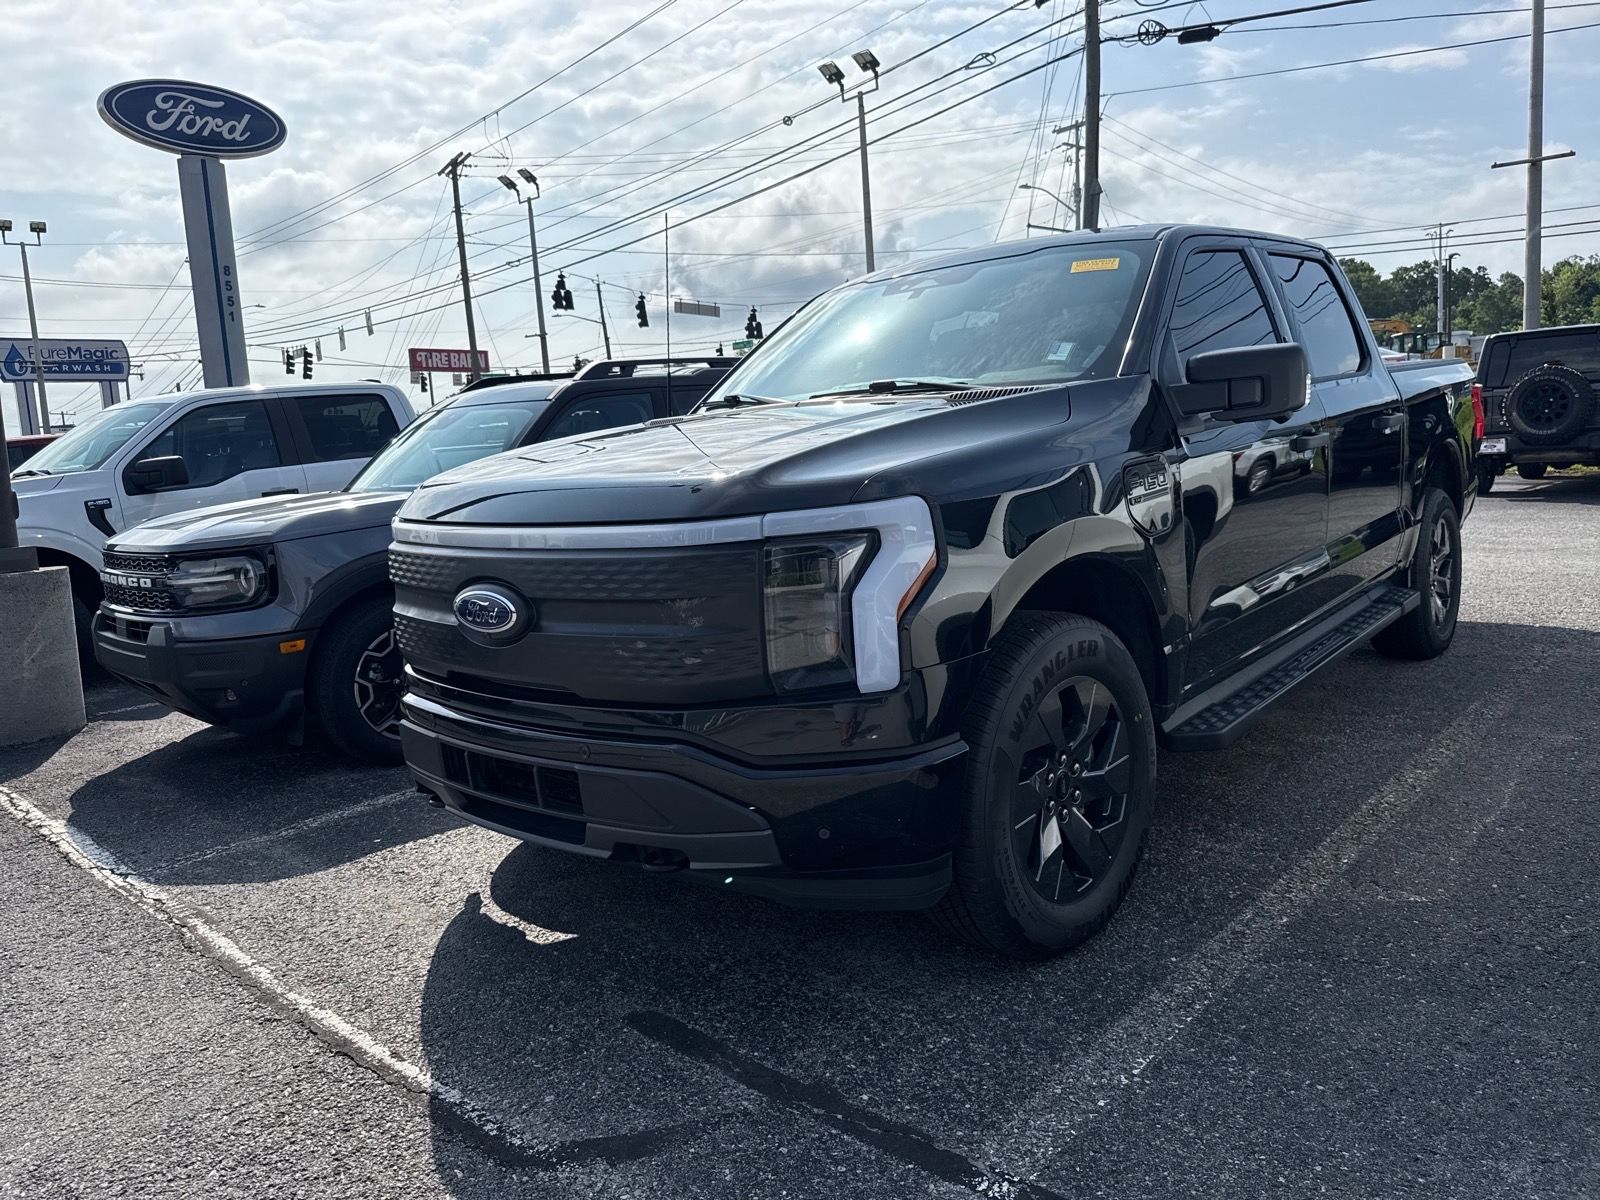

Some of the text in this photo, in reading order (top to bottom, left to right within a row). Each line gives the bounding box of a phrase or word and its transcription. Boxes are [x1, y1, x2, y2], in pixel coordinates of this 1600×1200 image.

[146, 91, 251, 141] Ford
[223, 265, 235, 322] 8551
[100, 572, 151, 588] BRONCO
[467, 599, 498, 623] Ford
[1008, 640, 1099, 742] WRANGLER
